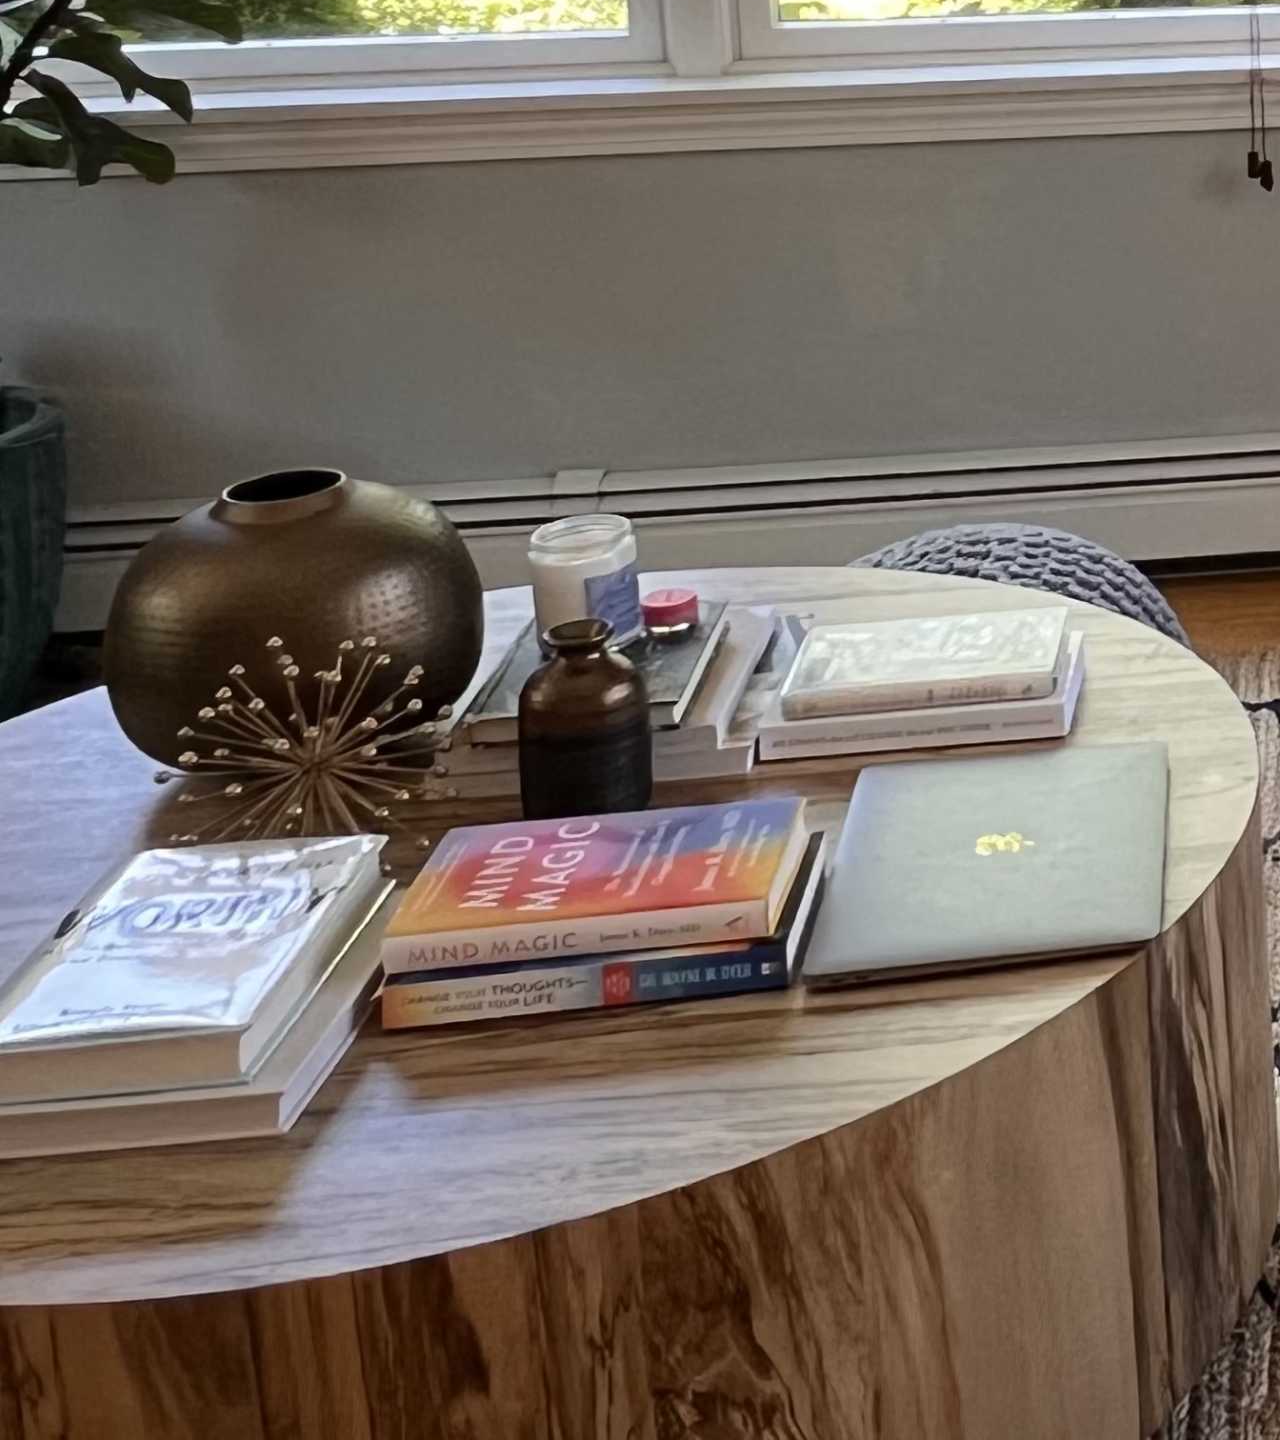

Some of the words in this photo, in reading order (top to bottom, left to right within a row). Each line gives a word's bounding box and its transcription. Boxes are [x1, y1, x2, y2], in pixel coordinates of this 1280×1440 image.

[457, 836, 536, 910] MIND
[514, 820, 602, 912] MAGIC
[408, 942, 480, 965] MIND
[490, 932, 578, 955] MAGIC
[523, 992, 554, 1007] LIFE
